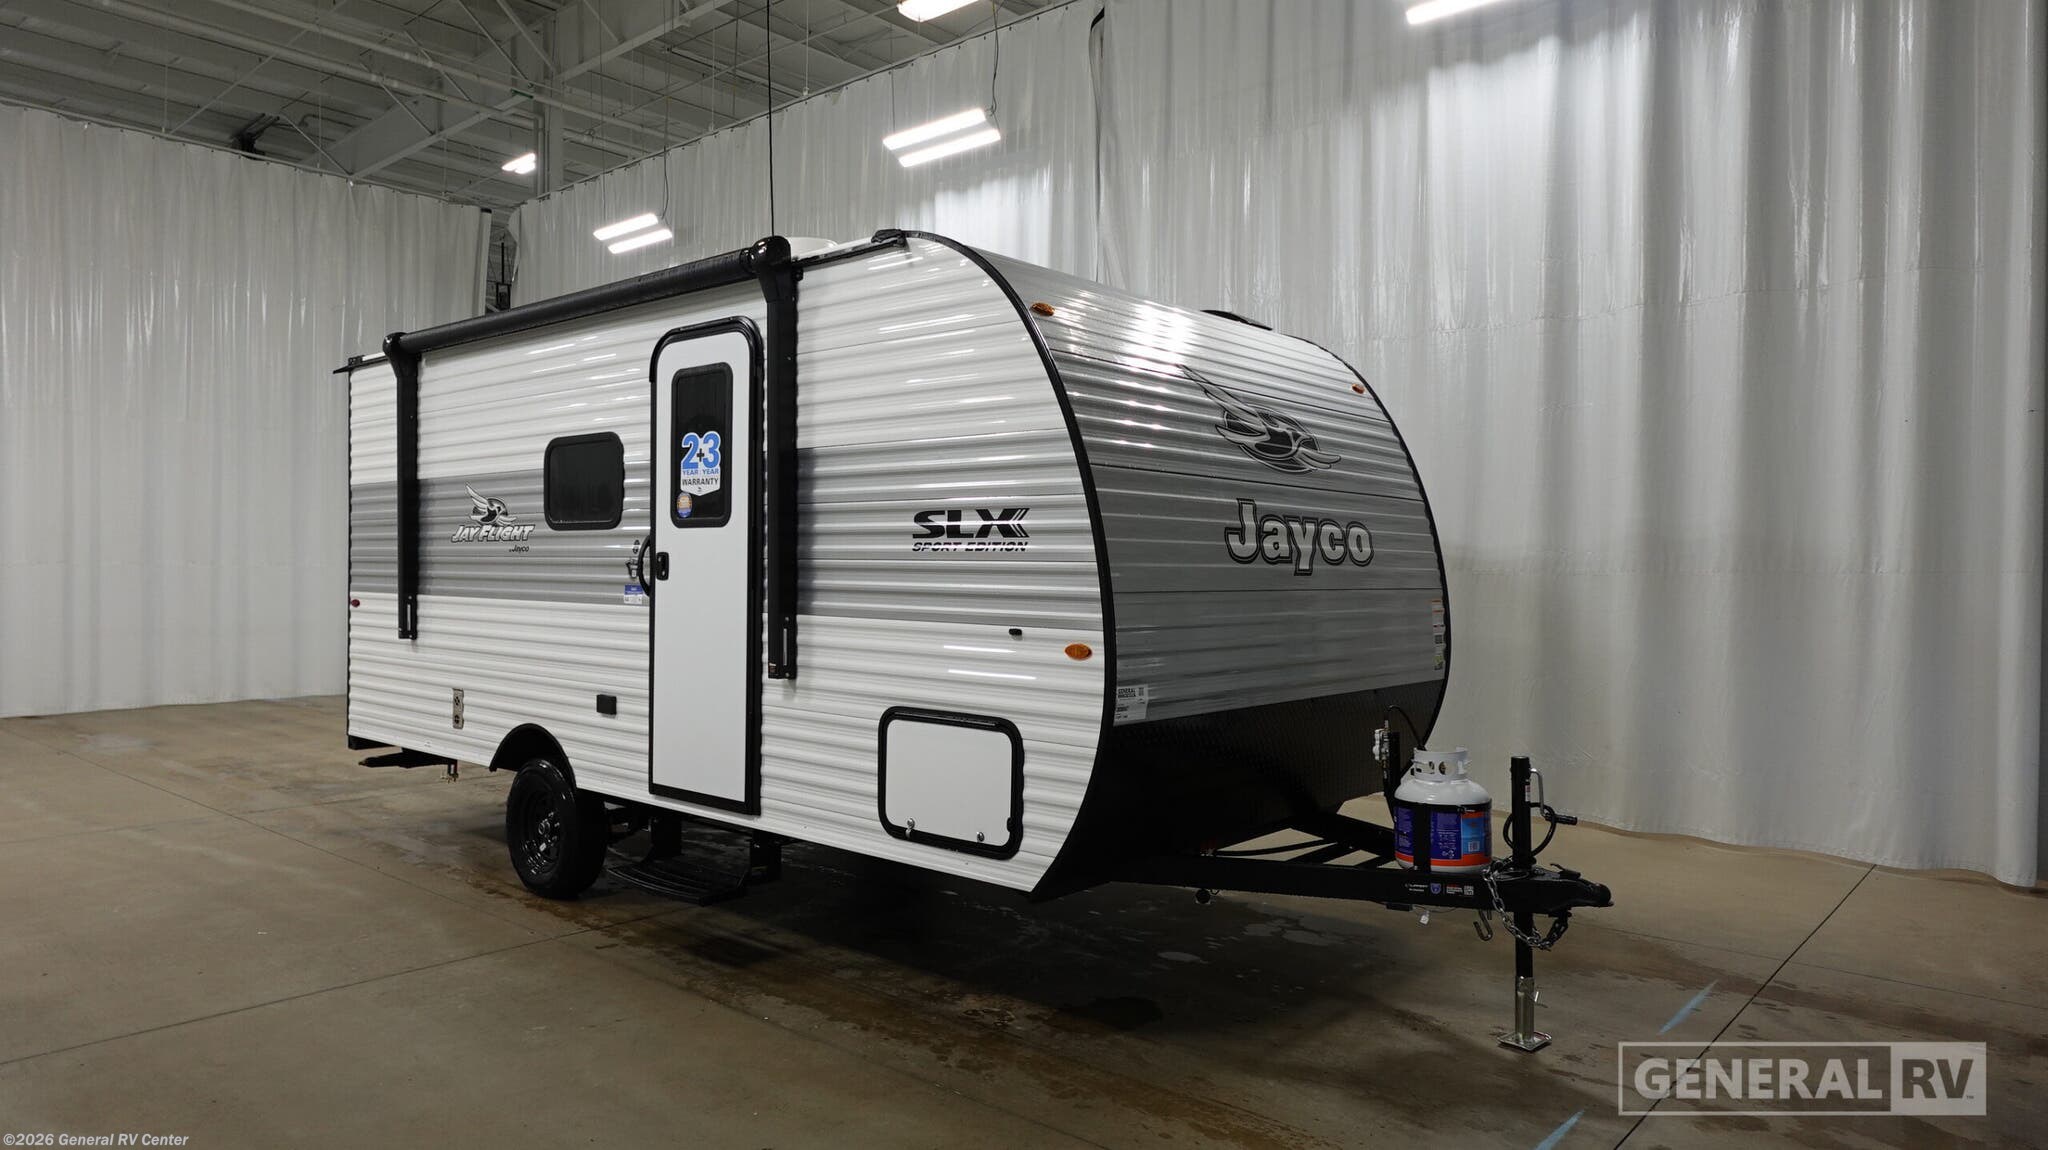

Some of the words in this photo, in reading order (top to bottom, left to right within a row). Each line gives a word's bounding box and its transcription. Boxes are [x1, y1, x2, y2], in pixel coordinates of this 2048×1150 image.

[682, 478, 718, 486] WARRANTY
[912, 508, 1030, 538] SLX
[451, 525, 480, 543] JAY
[478, 524, 535, 542] FLIGHT
[1224, 498, 1374, 576] Jayco
[912, 542, 962, 552] SPORT
[965, 542, 1029, 552] EDITION
